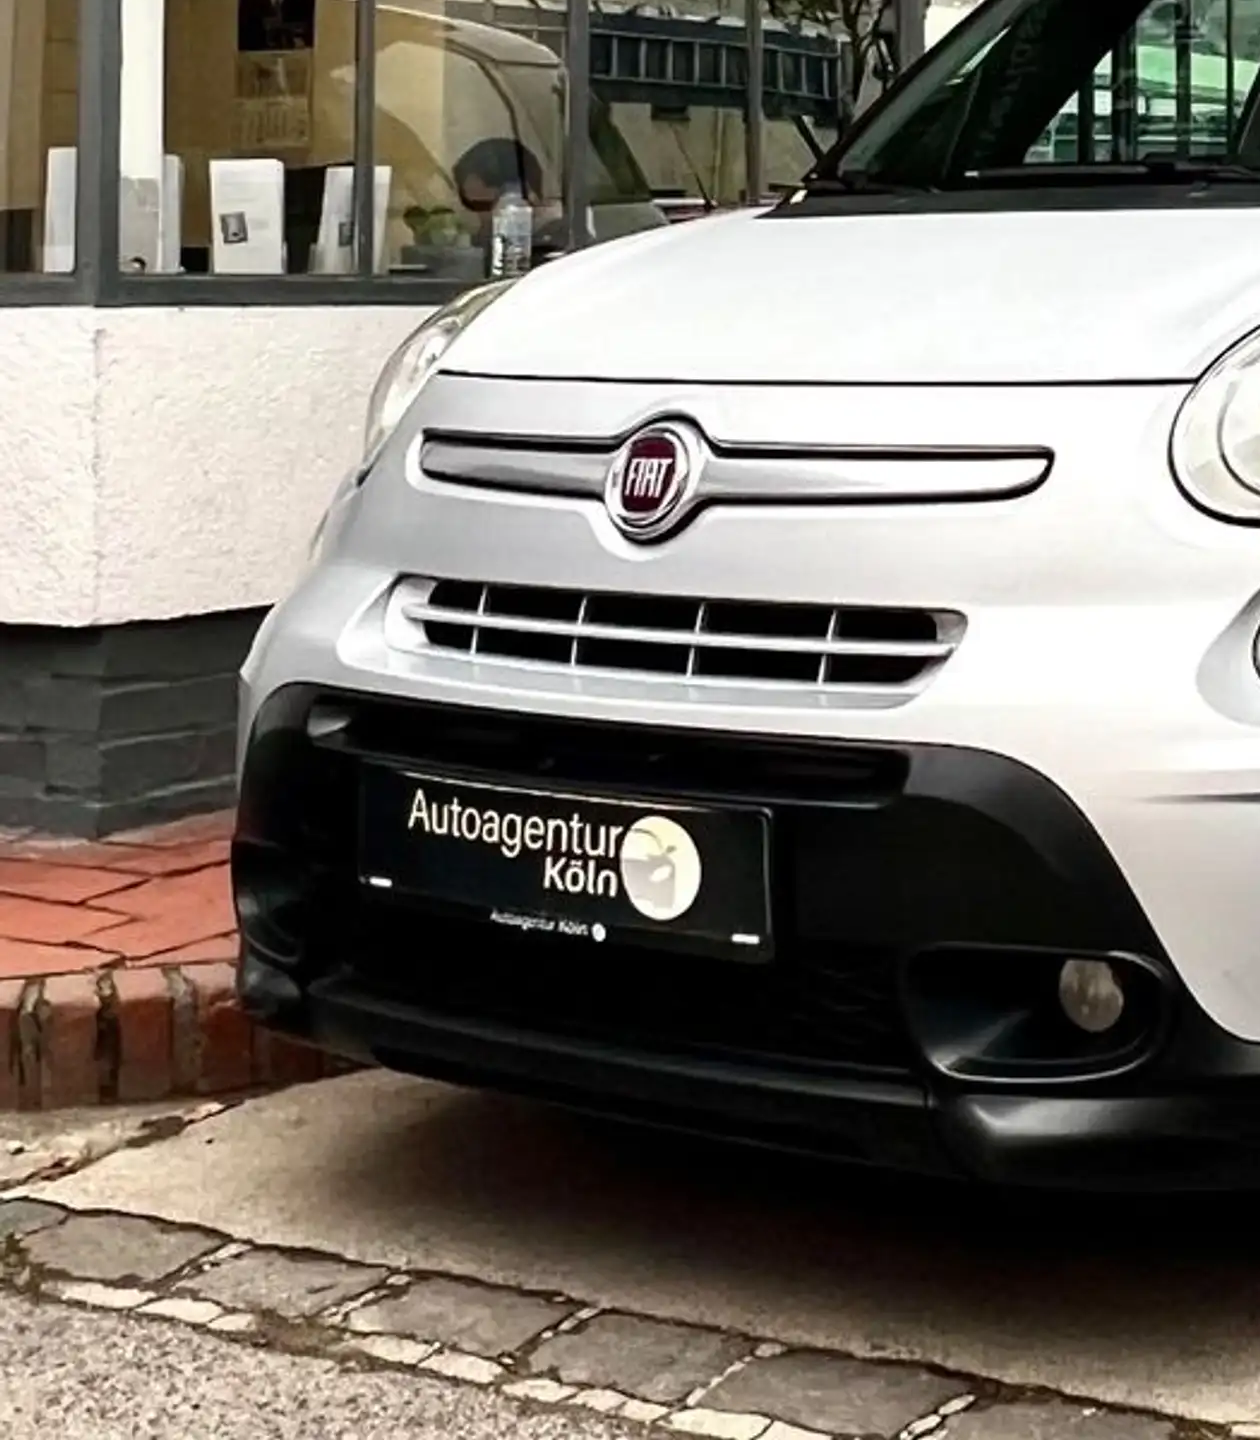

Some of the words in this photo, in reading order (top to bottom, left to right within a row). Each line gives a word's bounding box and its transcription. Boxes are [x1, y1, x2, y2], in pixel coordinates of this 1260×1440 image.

[624, 458, 673, 498] FIAT
[407, 788, 623, 858] Autoagentur
[543, 856, 619, 897] Köln
